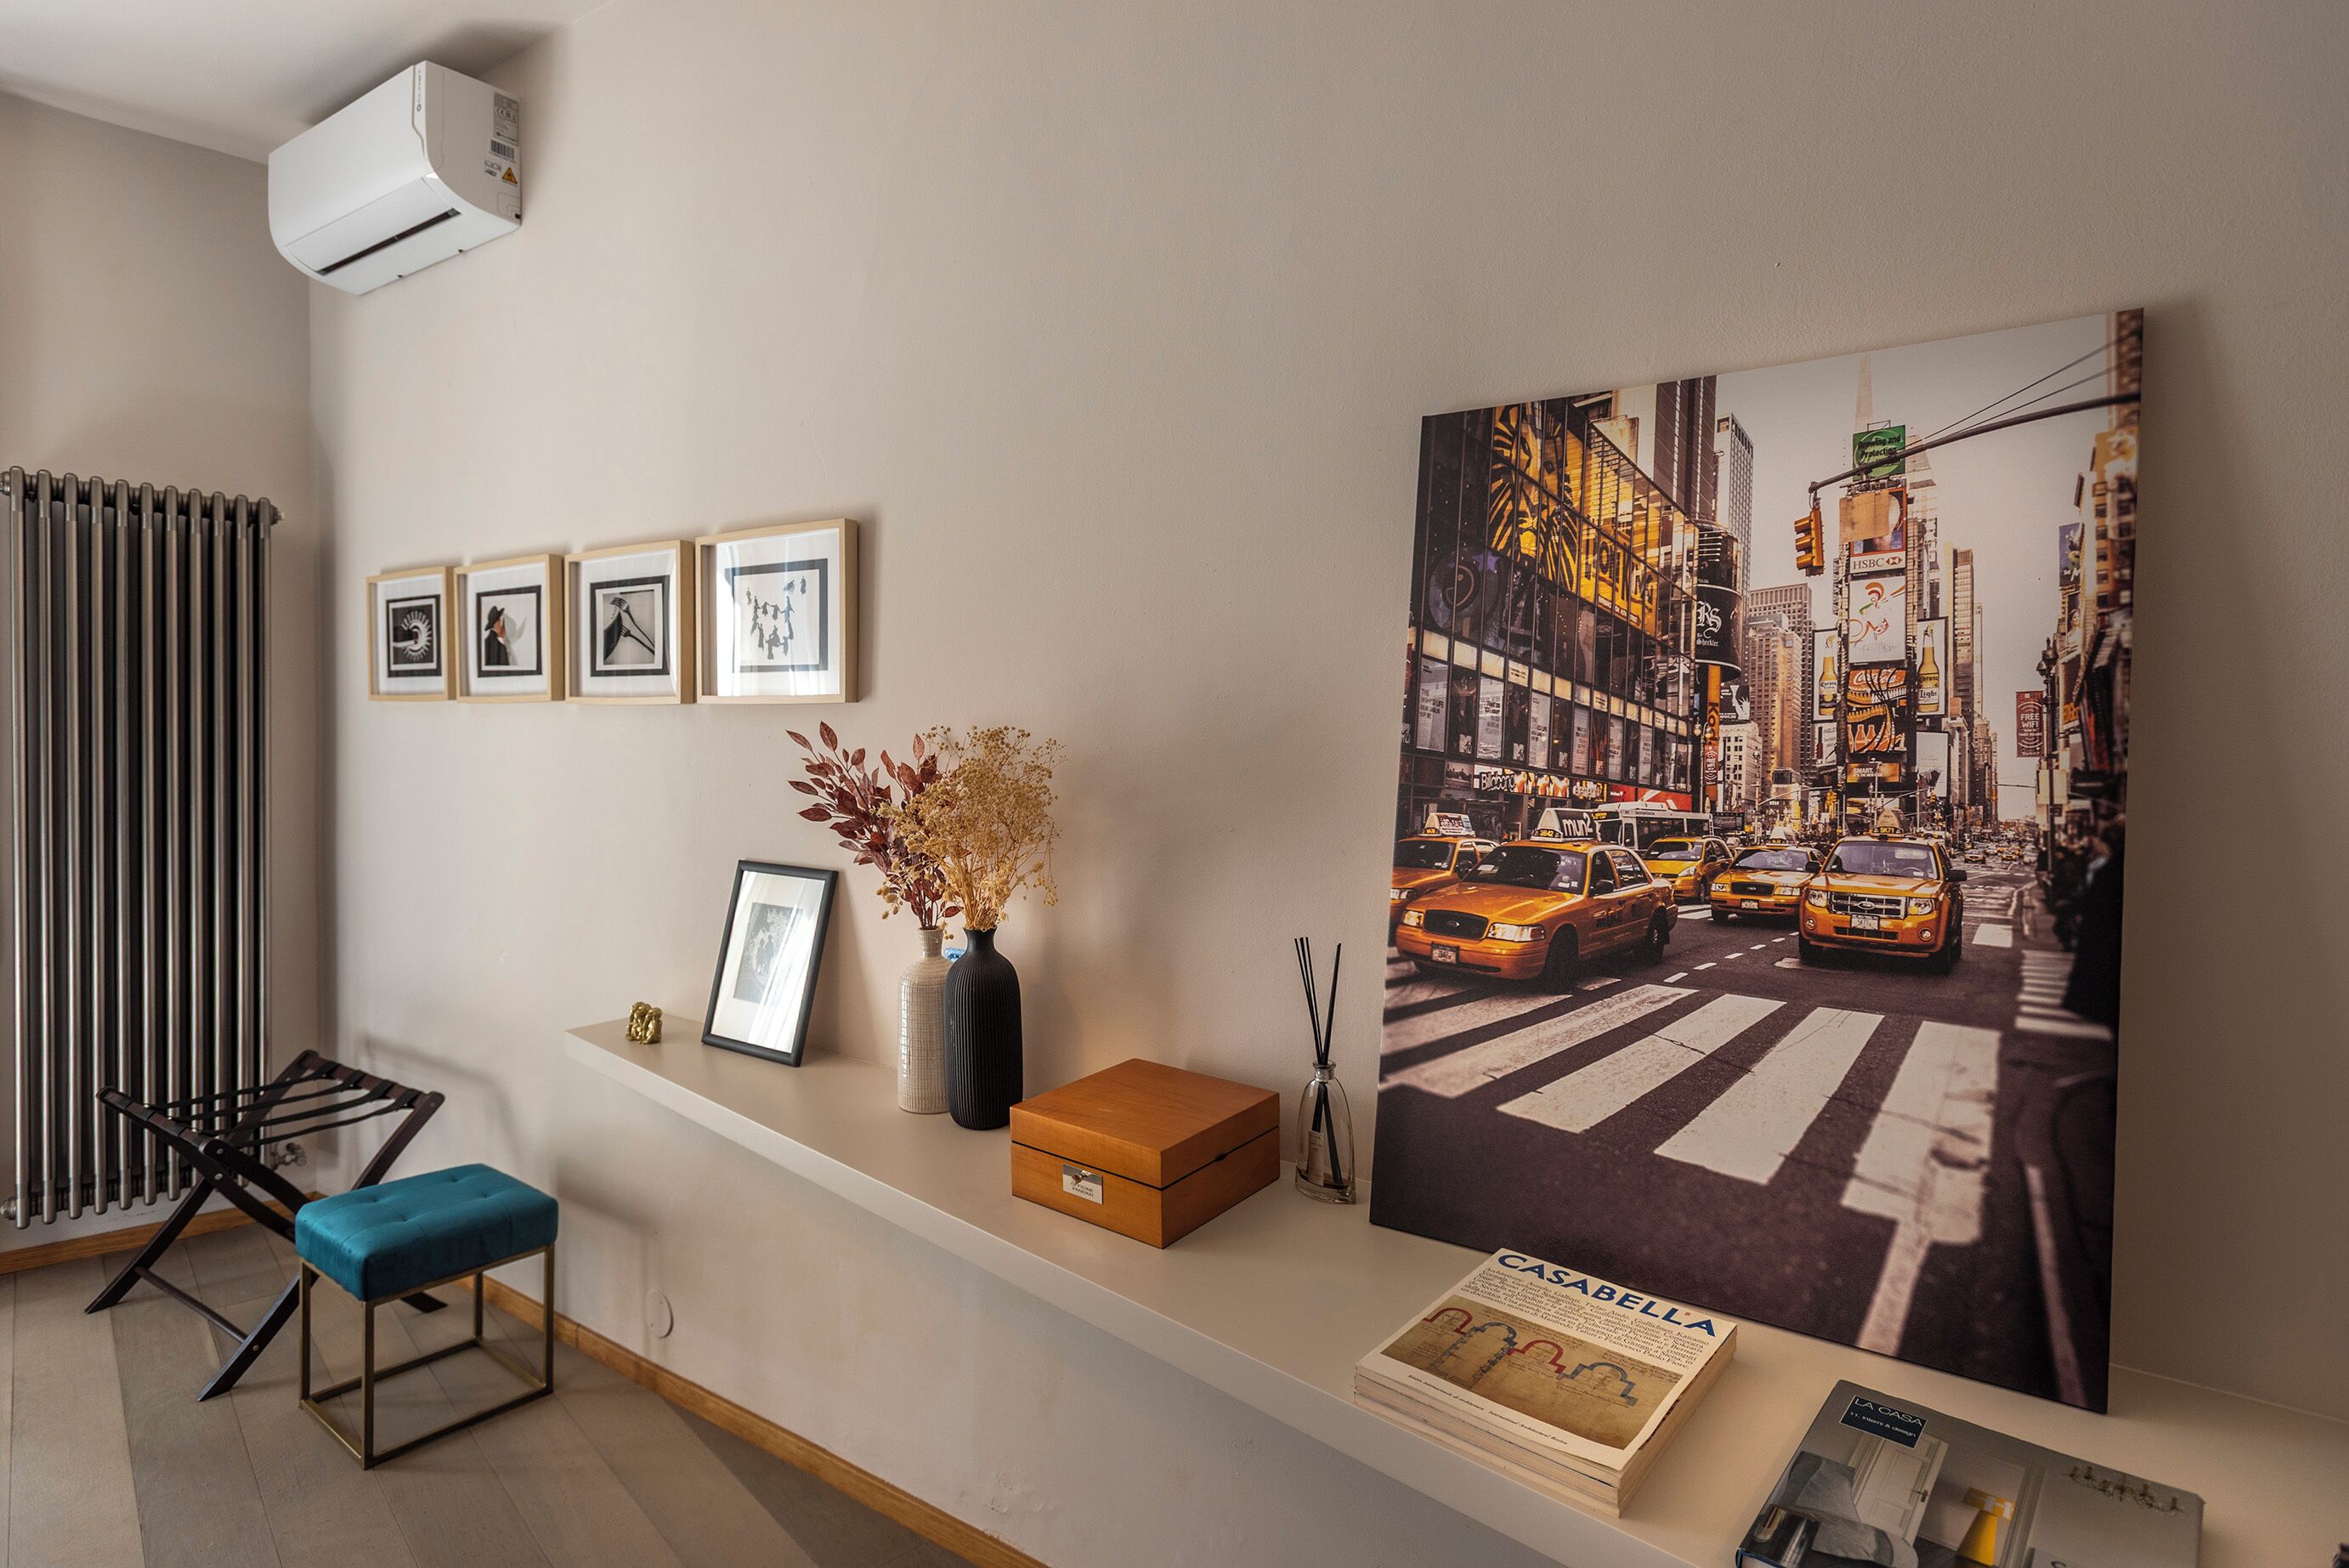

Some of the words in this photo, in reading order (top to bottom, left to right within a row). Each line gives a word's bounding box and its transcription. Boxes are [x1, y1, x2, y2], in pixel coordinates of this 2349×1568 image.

[1888, 433, 1901, 443] and
[1853, 558, 1884, 570] HSBC
[1920, 689, 1938, 699] Light
[1562, 812, 1594, 837] mun2
[1474, 1276, 1507, 1291] Georgiadis
[1514, 1292, 1543, 1304] Giedion
[1599, 1320, 1627, 1332] Giorgio
[1628, 1329, 1662, 1344] Piccinato
[1497, 1254, 1716, 1337] CASABELLA
[1498, 1280, 1519, 1289] Bruno
[1521, 1288, 1546, 1299] Fortier
[1582, 1311, 1602, 1320] senza
[1602, 1318, 1661, 1339] agglomerazione
[1512, 1281, 1541, 1293] Gerhard
[1590, 1309, 1626, 1322] Guillermo
[1527, 1282, 1552, 1293] Aurelio
[1586, 1301, 1606, 1311] Tadao
[1470, 1291, 1506, 1305] documento
[1507, 1304, 1530, 1313] storico
[1539, 1315, 1573, 1328] Manfredo
[1576, 1326, 1598, 1338] Tafuri
[1604, 1336, 1641, 1352] Francesco
[1643, 1350, 1665, 1361] Paolo
[1480, 1283, 1501, 1293] Secchi
[1584, 1319, 1619, 1334] Editoriale
[1622, 1333, 1654, 1346] dedicato
[1667, 1349, 1697, 1361] compiti
[1517, 1304, 1542, 1313] grande
[1542, 1311, 1566, 1322] mostra
[1576, 1322, 1613, 1338] Francesco
[1623, 1339, 1652, 1352] Giorgio
[1854, 1398, 1873, 1411] LA
[1878, 1407, 1922, 1427] CASA
[1892, 1427, 1916, 1438] design
